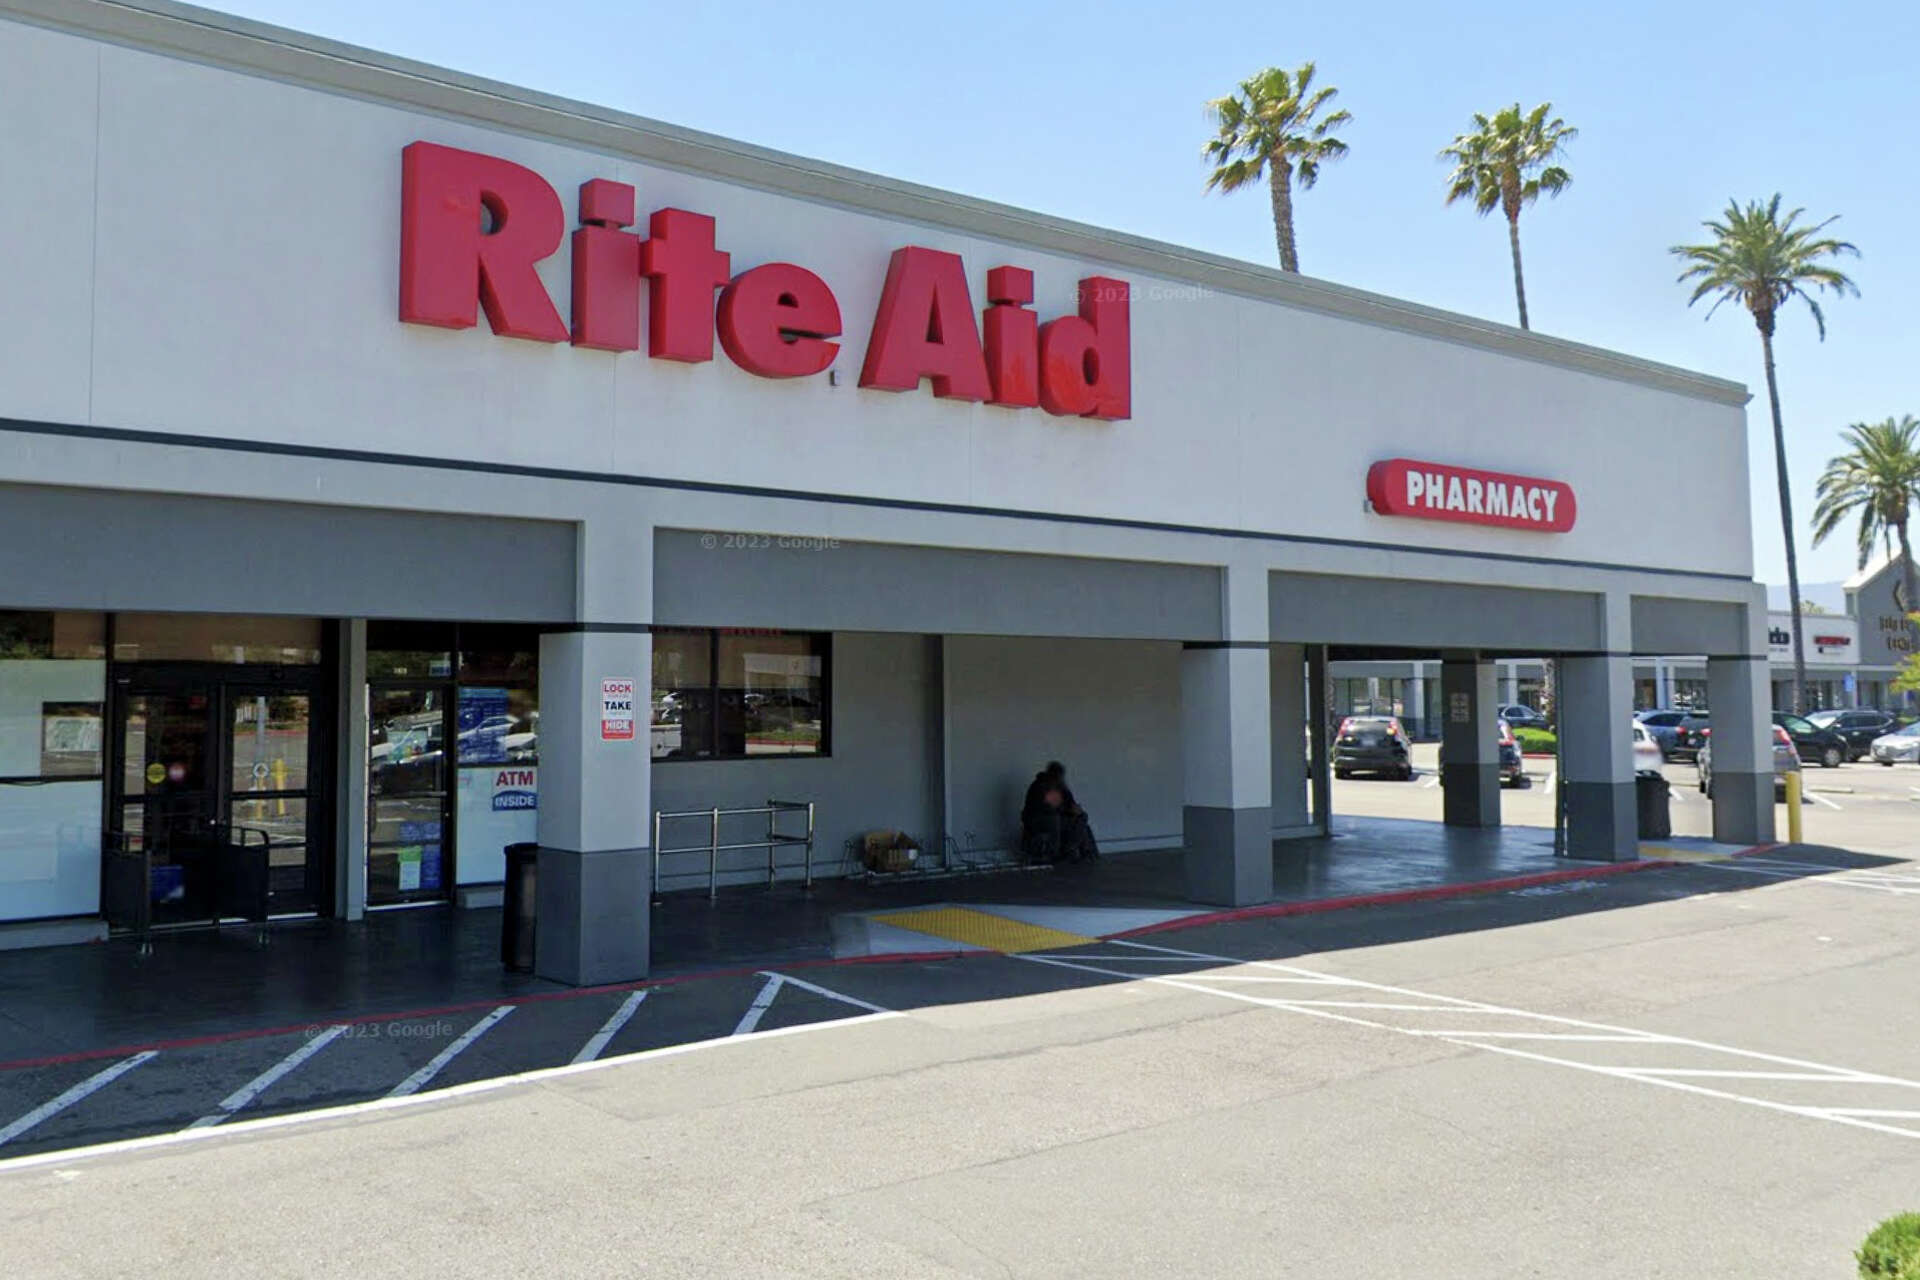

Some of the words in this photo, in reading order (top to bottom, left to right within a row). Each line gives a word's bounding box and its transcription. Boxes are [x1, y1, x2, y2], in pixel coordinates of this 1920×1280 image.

[399, 139, 843, 379] Rite
[857, 245, 1131, 421] Aid
[1405, 470, 1558, 523] PHARMACY
[604, 684, 632, 693] LOCK
[604, 701, 632, 711] TAKE
[605, 720, 631, 731] HIDE
[496, 771, 534, 787] ATM
[494, 795, 536, 808] INSIDE
